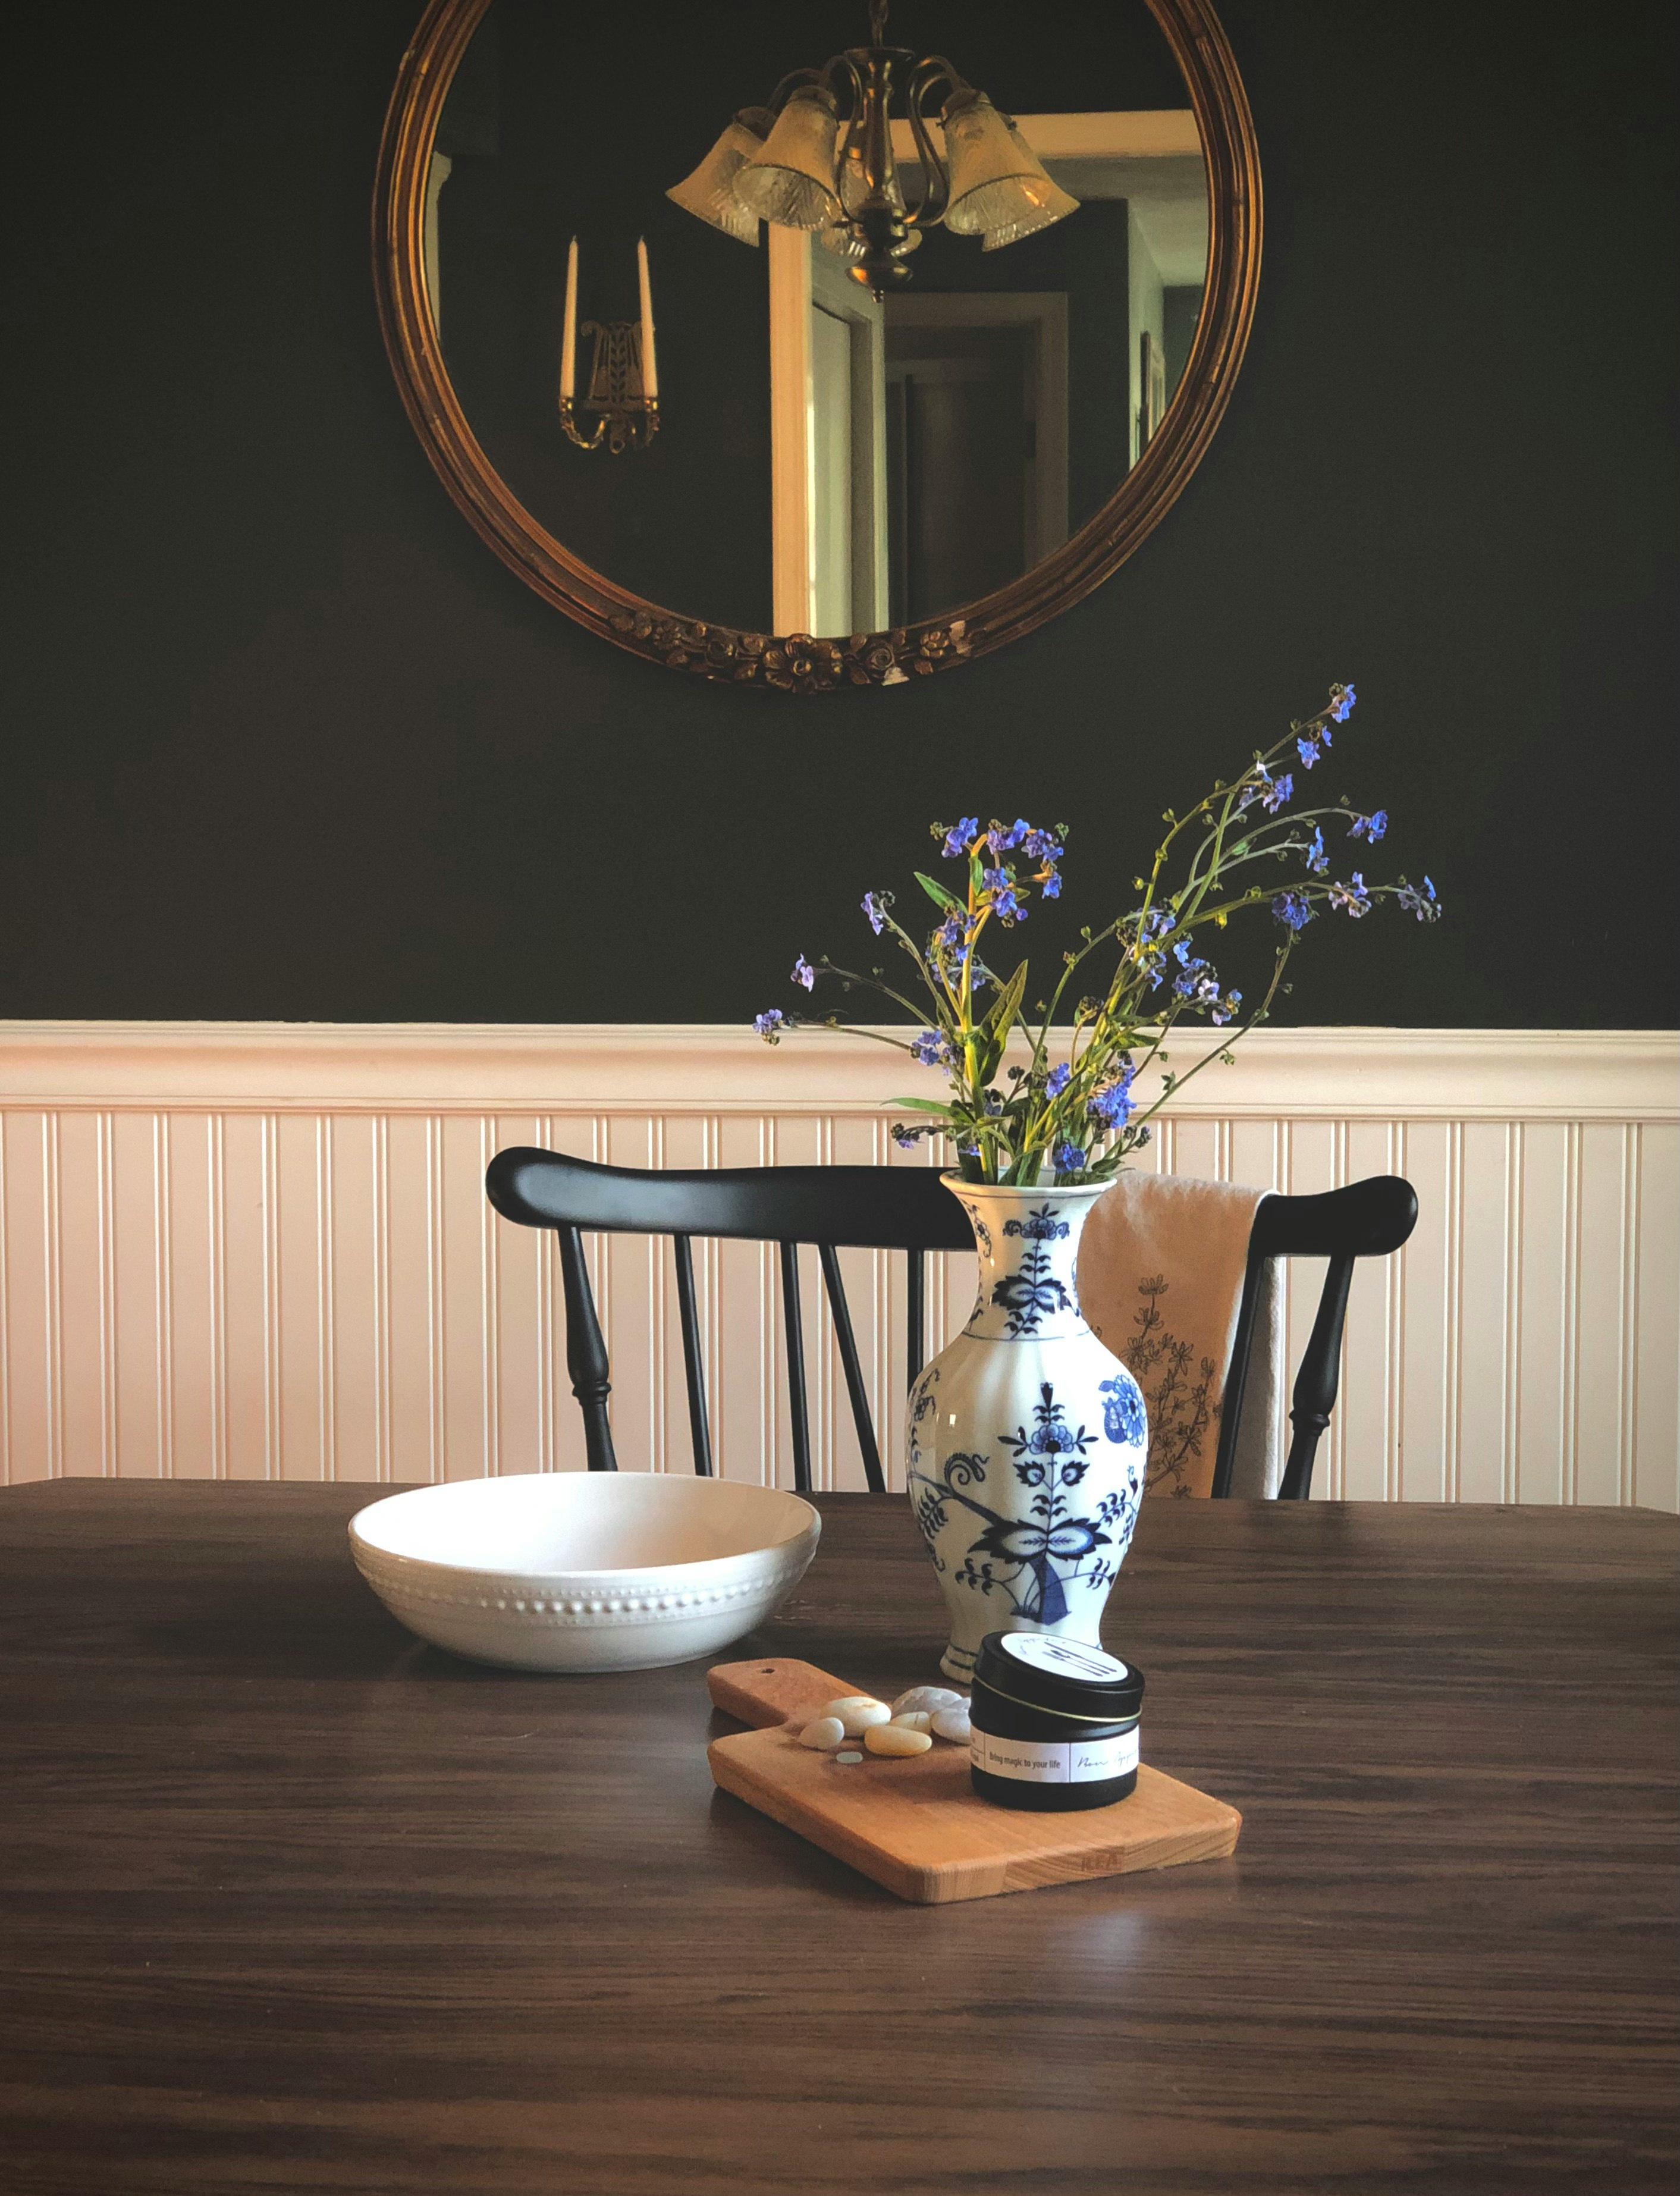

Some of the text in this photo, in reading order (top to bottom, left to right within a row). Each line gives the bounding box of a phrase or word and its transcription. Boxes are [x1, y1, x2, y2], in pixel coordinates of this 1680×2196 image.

[1004, 1757, 1022, 1768] magic
[1024, 1759, 1031, 1767] to
[1032, 1760, 1047, 1770] your
[1049, 1759, 1060, 1768] life
